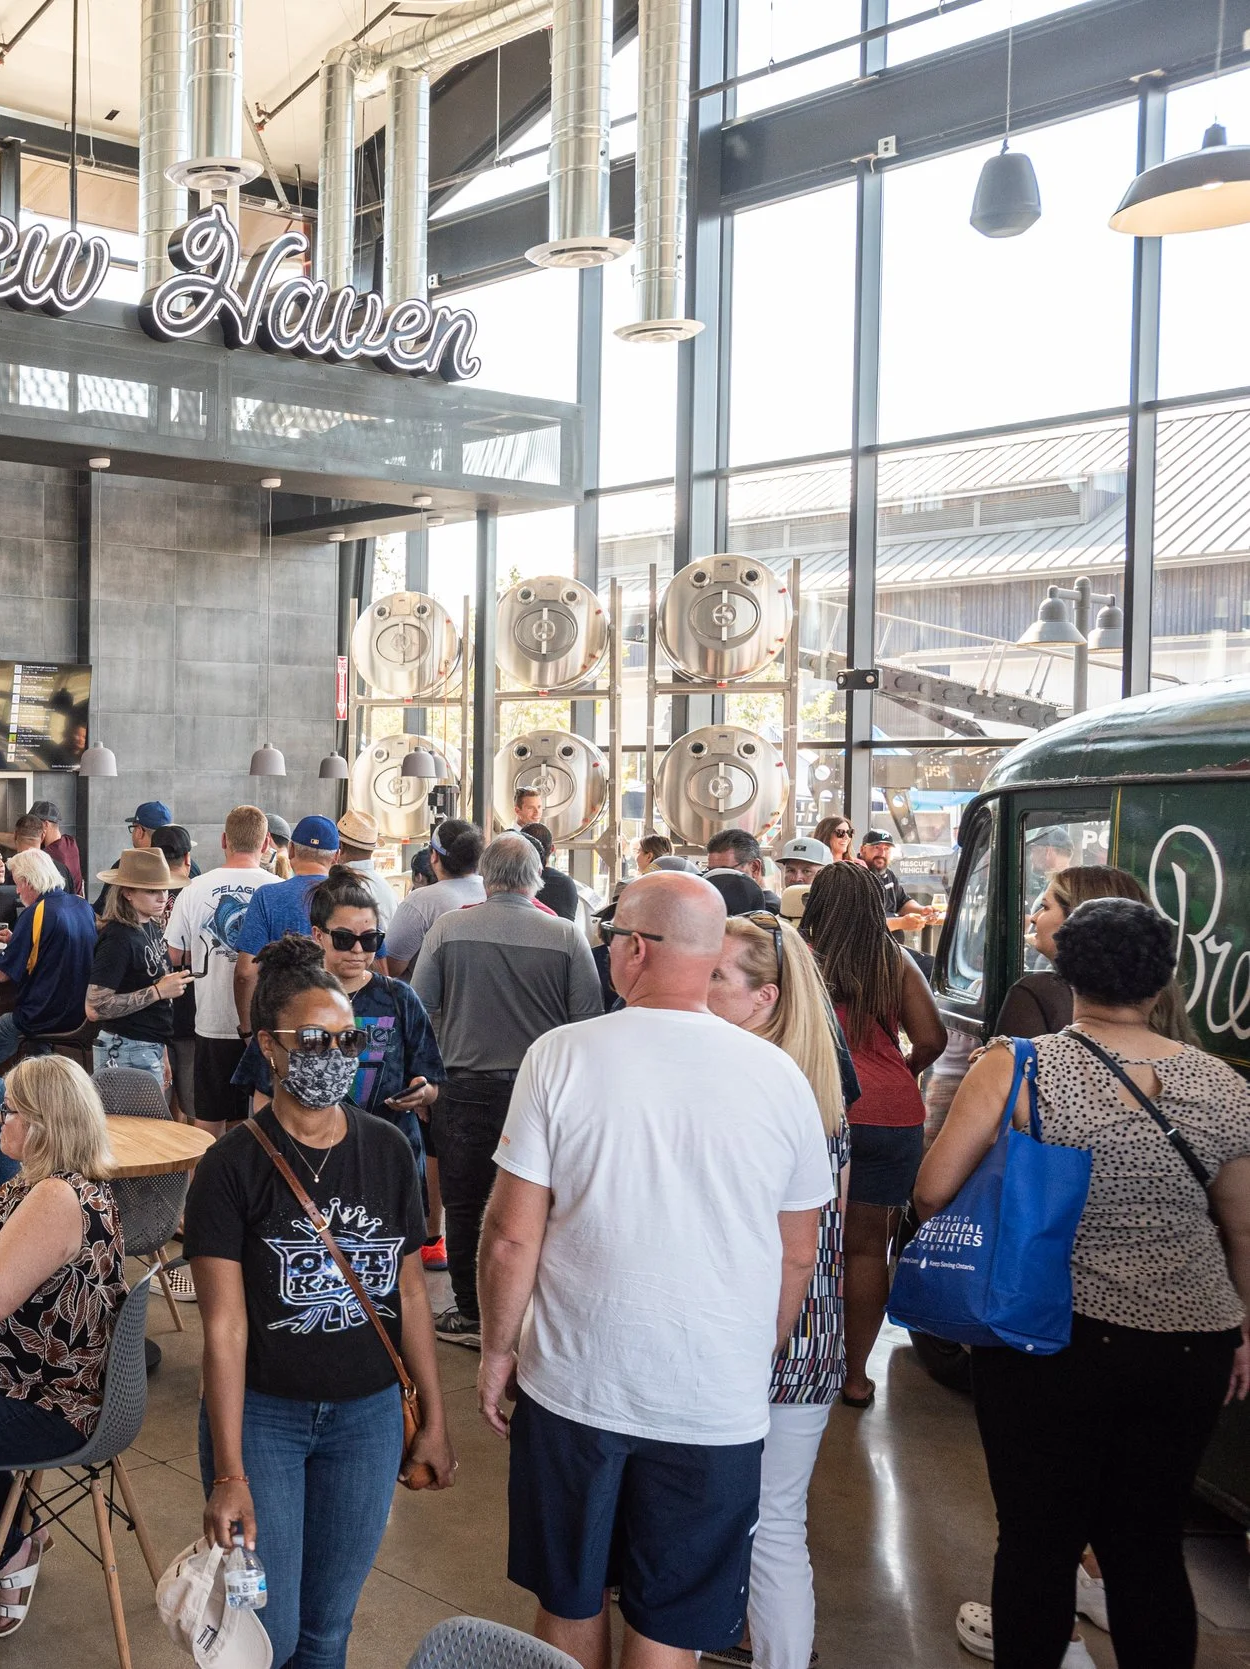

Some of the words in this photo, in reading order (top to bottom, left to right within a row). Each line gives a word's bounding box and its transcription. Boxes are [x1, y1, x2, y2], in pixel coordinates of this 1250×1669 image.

[146, 203, 482, 380] Haven
[922, 1221, 983, 1235] MUNICIPAL
[918, 1229, 983, 1247] UTILITIES
